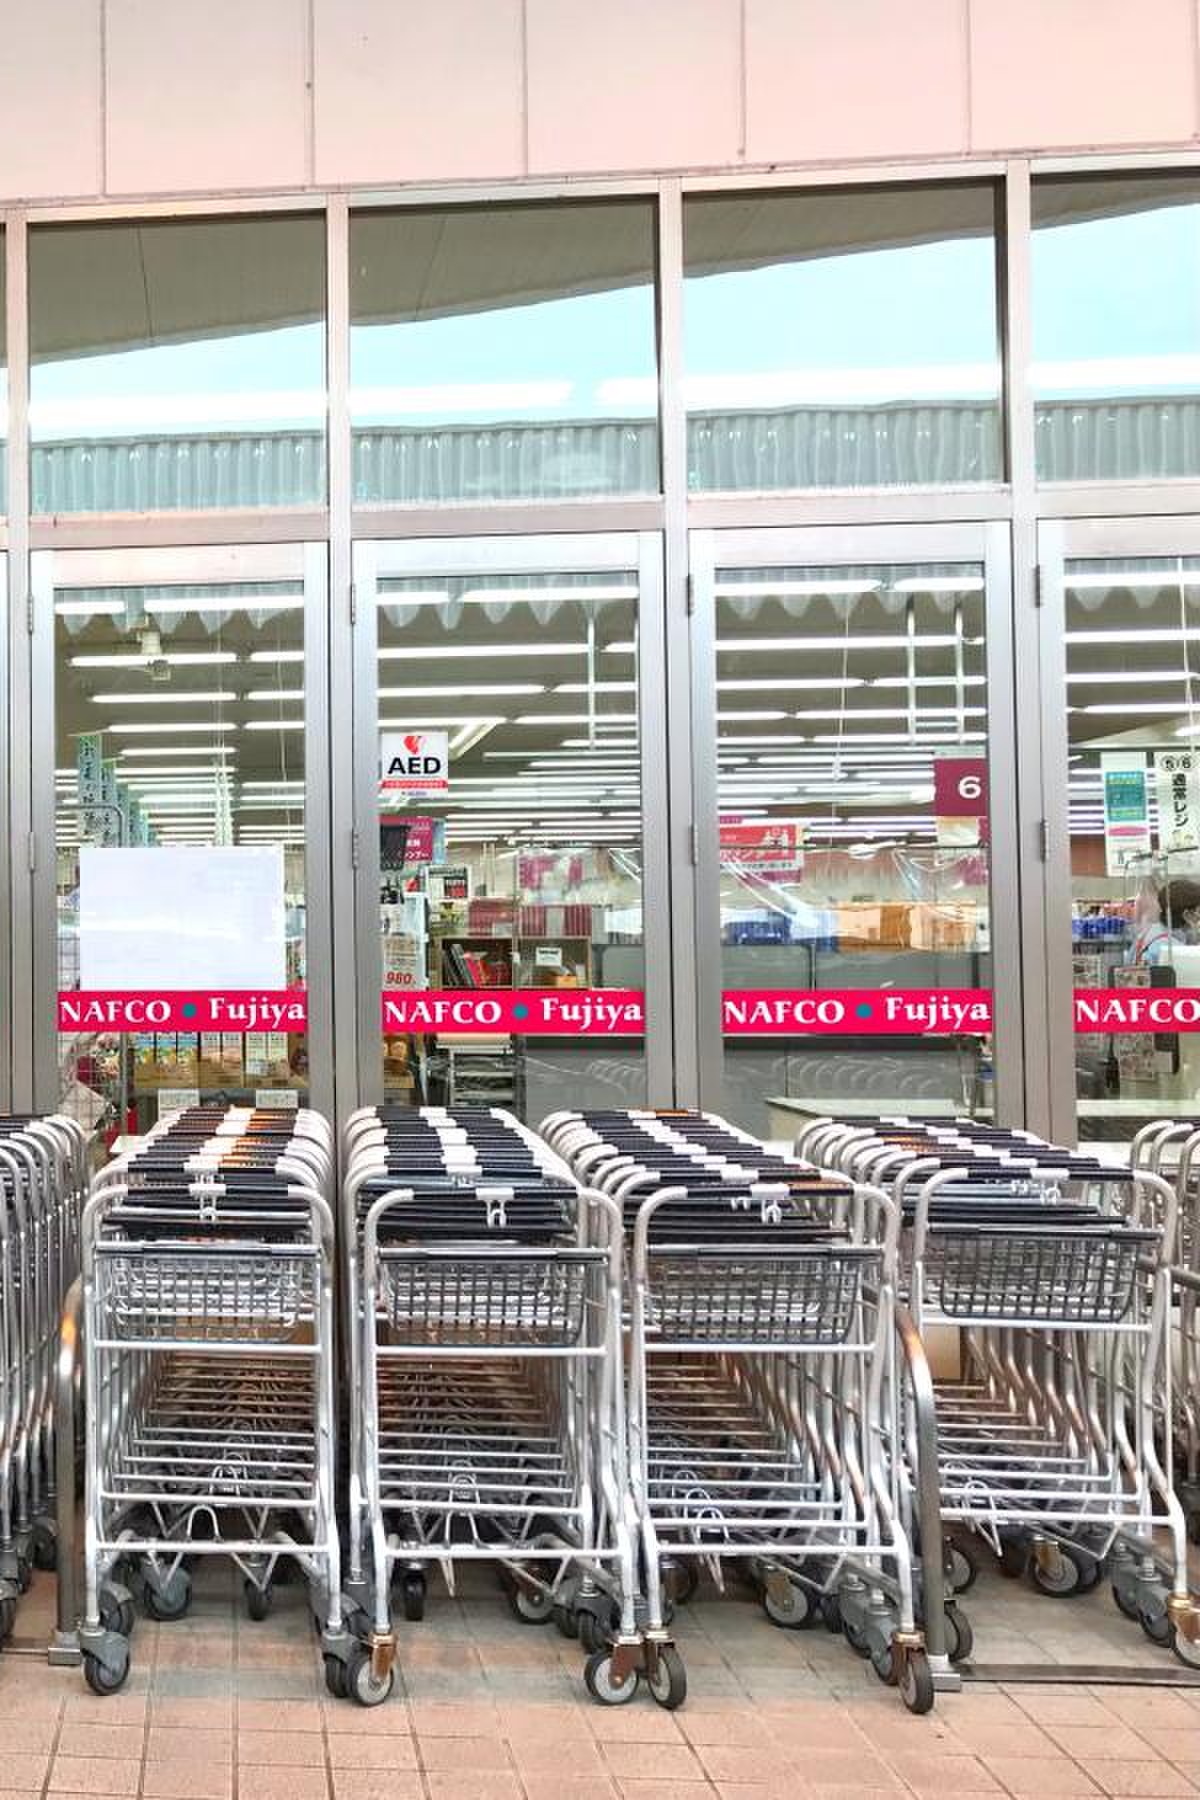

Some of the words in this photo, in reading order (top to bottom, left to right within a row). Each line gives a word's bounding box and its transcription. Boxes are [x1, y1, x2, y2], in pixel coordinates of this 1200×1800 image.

[387, 757, 441, 775] AED
[957, 776, 982, 798] 6
[60, 1000, 171, 1023] NAFCO
[210, 997, 305, 1028] Fujiya
[385, 1000, 502, 1023] NAFCO
[541, 997, 642, 1029] Fujiya
[724, 999, 845, 1024] NAFCO
[886, 996, 990, 1029] Fujiya
[1076, 998, 1200, 1024] NAFCO
